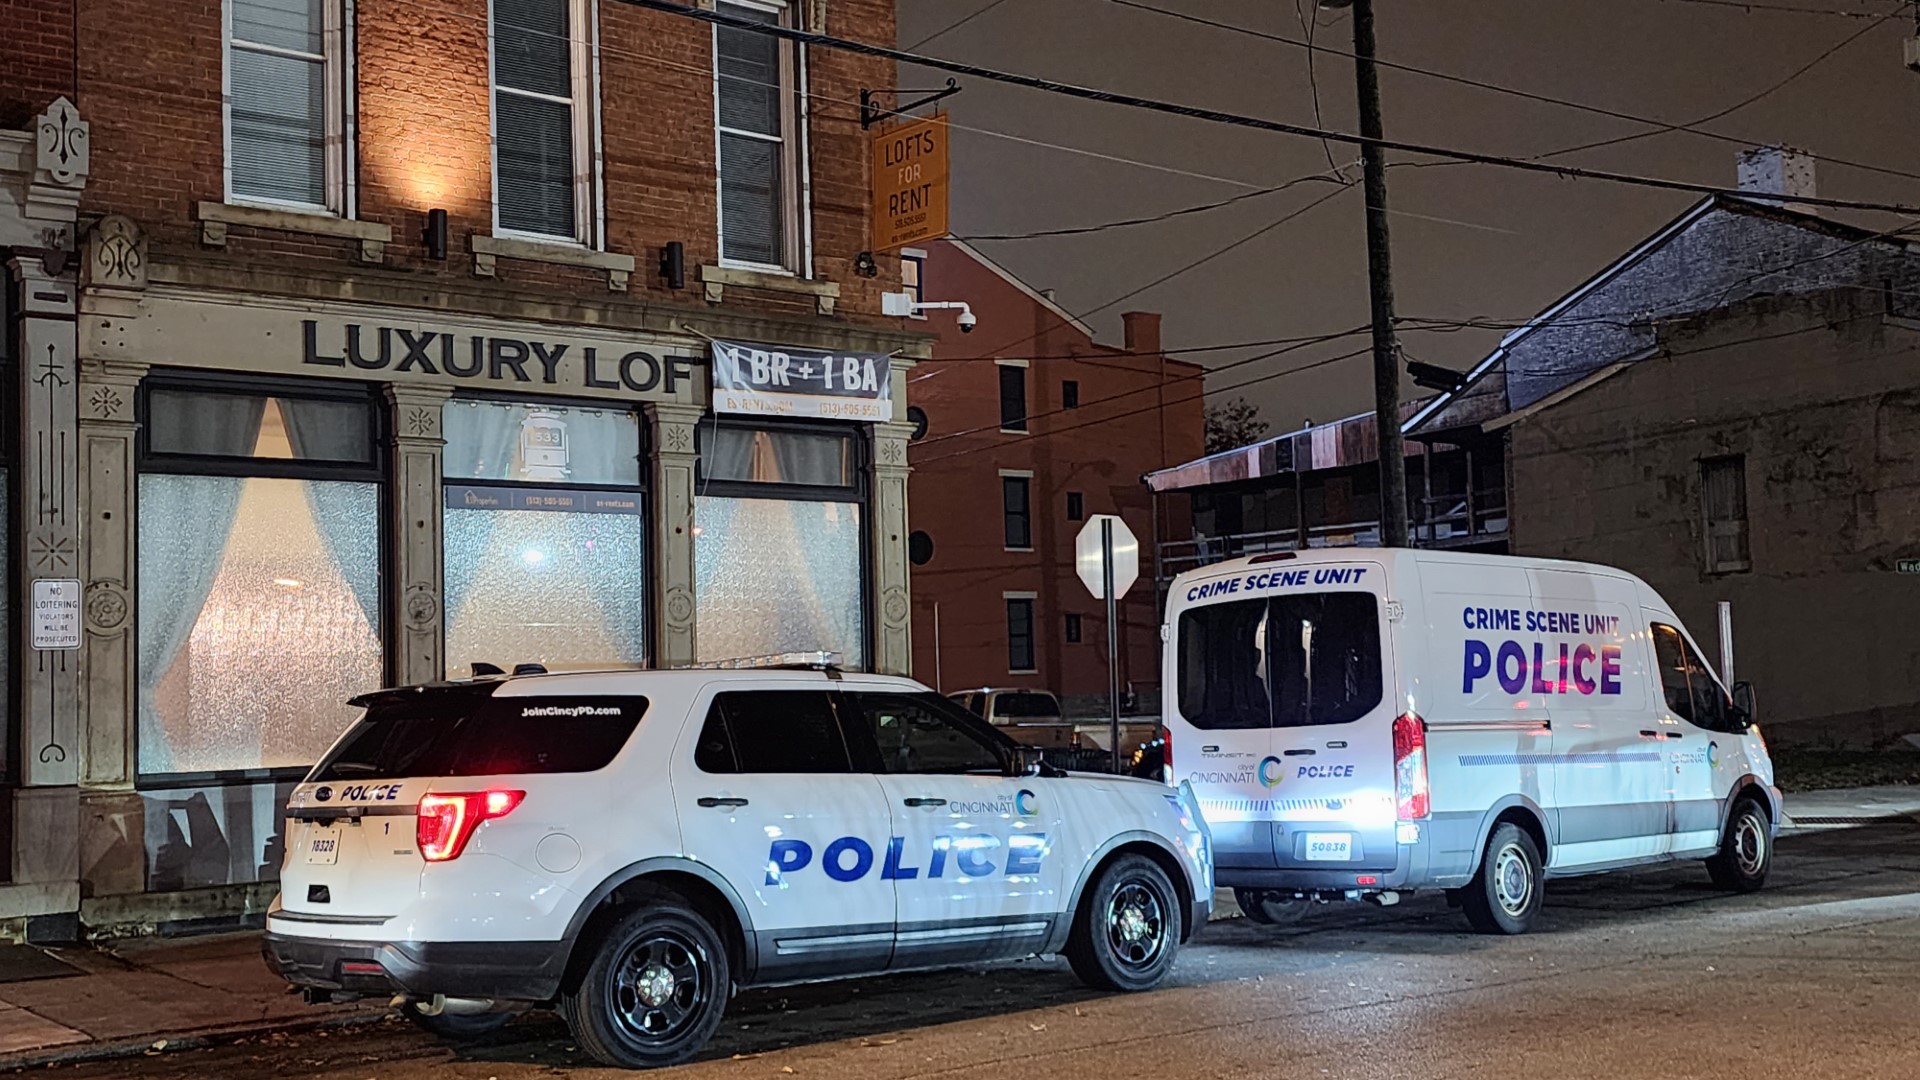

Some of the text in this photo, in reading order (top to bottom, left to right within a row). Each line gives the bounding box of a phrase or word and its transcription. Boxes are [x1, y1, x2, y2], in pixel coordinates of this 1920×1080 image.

[885, 130, 934, 167] LOFTS
[898, 163, 921, 186] FOR
[889, 183, 932, 218] RENT
[302, 319, 570, 385] LUXURY
[727, 348, 878, 392] 1 BR + 1 BA
[50, 587, 63, 596] NO
[1187, 568, 1367, 602] CRIME SCENE UNIT
[35, 600, 78, 609] LOITERING
[44, 624, 58, 632] WILL
[1463, 606, 1619, 635] CRIME SCENE UNIT
[36, 635, 77, 643] PROSECUTED
[1462, 639, 1622, 695] POLICE
[521, 706, 621, 717] JoinCincyPD.com
[1190, 771, 1255, 784] CINCINNATI
[1297, 764, 1355, 779] POLICE
[340, 783, 403, 801] POLICE
[949, 801, 1015, 814] CINCINNATI
[384, 822, 390, 835] 1
[311, 840, 335, 852] 18328
[1310, 842, 1347, 852] 50838
[764, 832, 1047, 886] POLICE
